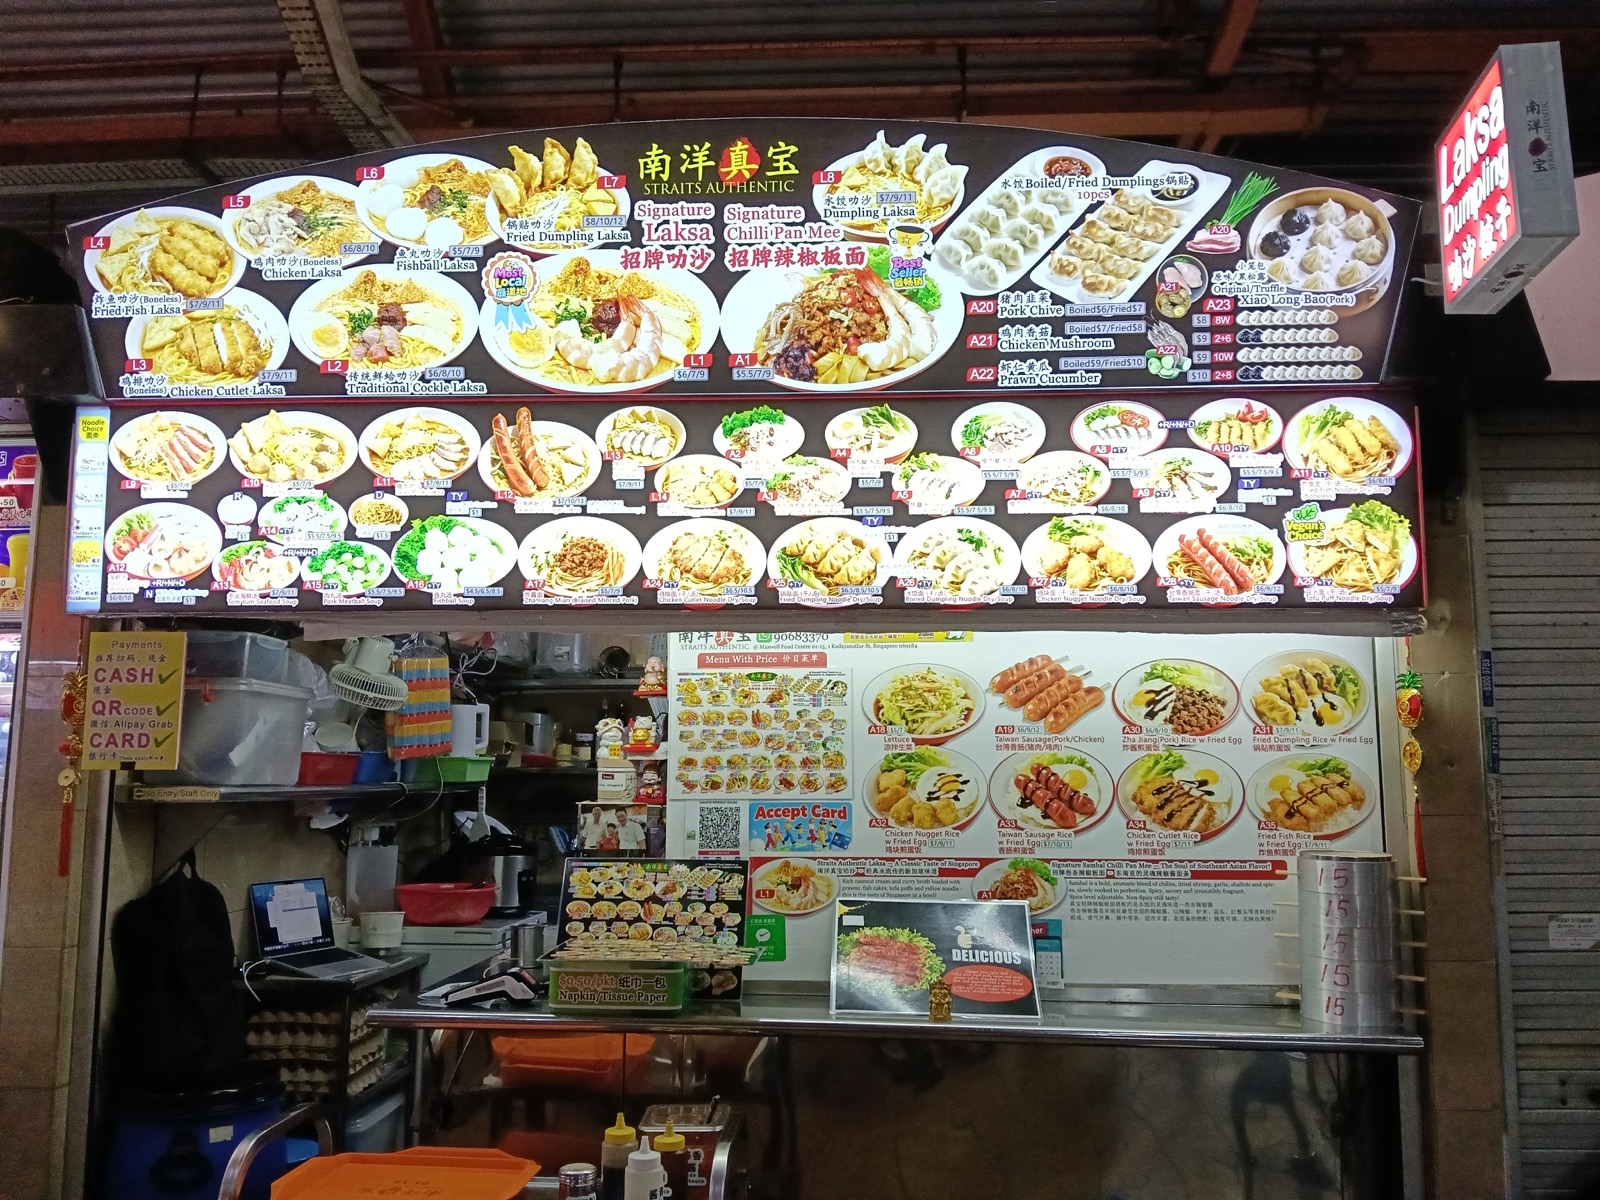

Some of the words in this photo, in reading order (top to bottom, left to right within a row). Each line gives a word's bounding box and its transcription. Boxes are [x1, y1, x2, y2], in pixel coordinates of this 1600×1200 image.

[1440, 85, 1505, 203] Laksa
[638, 141, 799, 181] 南洋真宝
[363, 168, 378, 179] L6
[820, 172, 835, 183] L8
[604, 177, 619, 188] L7
[644, 181, 702, 195] STRAITS
[706, 180, 794, 193] AUTHENTIC
[879, 192, 913, 202] $7/9/11
[1078, 190, 1110, 202] 10pcs
[1444, 142, 1509, 246] Dumpling
[229, 196, 244, 208] L5
[637, 204, 712, 220] Signature
[727, 207, 802, 223] Signature
[823, 207, 879, 220] Dumpling
[883, 207, 916, 217] Laksa
[585, 216, 623, 227] $8/10/12
[506, 231, 536, 242] Fried
[539, 230, 593, 244] Dumpling
[597, 230, 630, 241] Laksa
[646, 223, 712, 242] Laksa
[727, 225, 771, 241] Chilli
[774, 226, 805, 240] Pan
[808, 225, 841, 240] Mee
[90, 237, 104, 248] L4
[342, 244, 376, 254] $6/8/10
[452, 245, 480, 255] $5/7/9
[620, 249, 712, 270] 招牌叻沙
[728, 247, 866, 267] 招牌辣椒板面
[891, 256, 923, 268] Best
[396, 259, 439, 271] Fishball
[444, 260, 475, 271] Laksa
[264, 268, 308, 279] Chicken
[311, 267, 342, 279] Laksa
[494, 267, 523, 278] Most
[890, 267, 926, 280] Seller
[495, 275, 527, 289] Local
[1213, 284, 1284, 295] Original/Truffle
[188, 299, 221, 310] $7/9/11
[1206, 300, 1231, 311] A23
[1241, 295, 1268, 306] Xiao
[1271, 294, 1300, 307] Long
[1304, 294, 1354, 306] Bao(Pork)
[93, 305, 120, 316] Fried
[125, 305, 148, 315] Fish
[150, 304, 181, 315] Laksa
[970, 302, 993, 313] A20
[1001, 305, 1027, 317] Pork
[1030, 305, 1063, 316] Chive
[1069, 304, 1143, 314] Boiled$6/Fried$7
[1196, 316, 1207, 325] $8
[1215, 316, 1231, 325] 8W
[1069, 323, 1143, 334] Boiled$7/Fried$8
[970, 336, 993, 347] A21
[1000, 339, 1047, 350] Chicken
[1050, 338, 1112, 349] Mushroom
[1196, 334, 1207, 343] $9
[1215, 334, 1231, 343] 2+6
[690, 356, 705, 366] L1
[735, 355, 750, 365] A1
[1196, 353, 1207, 362] $9
[1214, 353, 1234, 362] 10W
[133, 360, 147, 371] L3
[327, 361, 342, 372] L2
[261, 371, 293, 381] $7/9/11
[428, 369, 461, 378] $6/8/10
[677, 369, 705, 379] $6/7/9
[735, 369, 771, 379] $5.5/7/9
[970, 369, 994, 380] A22
[1001, 374, 1036, 385] Prawn
[1039, 373, 1100, 384] Cucumber
[1192, 371, 1207, 381] $10
[1215, 371, 1232, 380] 2+8
[123, 386, 167, 397] (Boneless)
[170, 385, 214, 397] Chicken
[216, 385, 250, 396] Cutlet
[253, 384, 283, 396] Laksa
[348, 383, 410, 394] Traditional
[413, 382, 450, 394] Cockle
[453, 382, 485, 393] Laksa
[81, 419, 105, 427] Noodle
[125, 480, 137, 489] L9
[244, 479, 260, 487] L10
[1242, 479, 1257, 488] TY
[451, 492, 464, 500] TY
[1286, 521, 1326, 533] Vegan's
[1287, 531, 1324, 541] Choice
[774, 632, 829, 643] 90683370
[112, 640, 162, 649] Payments
[705, 655, 730, 664] Menu
[732, 655, 754, 663] With
[755, 655, 778, 663] Price
[94, 667, 154, 683] CASH
[91, 700, 122, 716] QR
[124, 707, 153, 716] CODE
[869, 726, 886, 734] A18
[997, 726, 1013, 734] A19
[1123, 726, 1142, 734] A30
[1254, 726, 1272, 734] A31
[89, 732, 151, 749] CARD
[883, 735, 910, 743] Lettuce
[995, 735, 1020, 743] Taiwan
[1122, 736, 1137, 744] Zha
[1181, 736, 1197, 744] Rice
[1207, 736, 1227, 744] Fried
[1228, 736, 1243, 745] Egg
[1253, 736, 1272, 744] Fried
[1273, 736, 1311, 745] Dumpling
[1312, 736, 1328, 744] Rice
[1338, 736, 1357, 744] Fried
[1359, 736, 1374, 745] Egg
[144, 789, 155, 797] No
[157, 789, 199, 798] Entry/Staff
[201, 789, 219, 799] Only
[755, 804, 808, 821] Accept
[811, 804, 848, 820] Card
[870, 819, 887, 828] A32
[885, 829, 913, 838] Chicken
[915, 830, 945, 840] Nugget
[946, 830, 960, 838] Rice
[760, 890, 770, 898] L1
[951, 948, 1022, 965] DELICIOUS
[559, 975, 616, 990] $0.50/pkt
[618, 976, 667, 990] 纸巾一包
[559, 991, 635, 1002] Napkin/Tissue
[636, 992, 667, 1004] Paper
